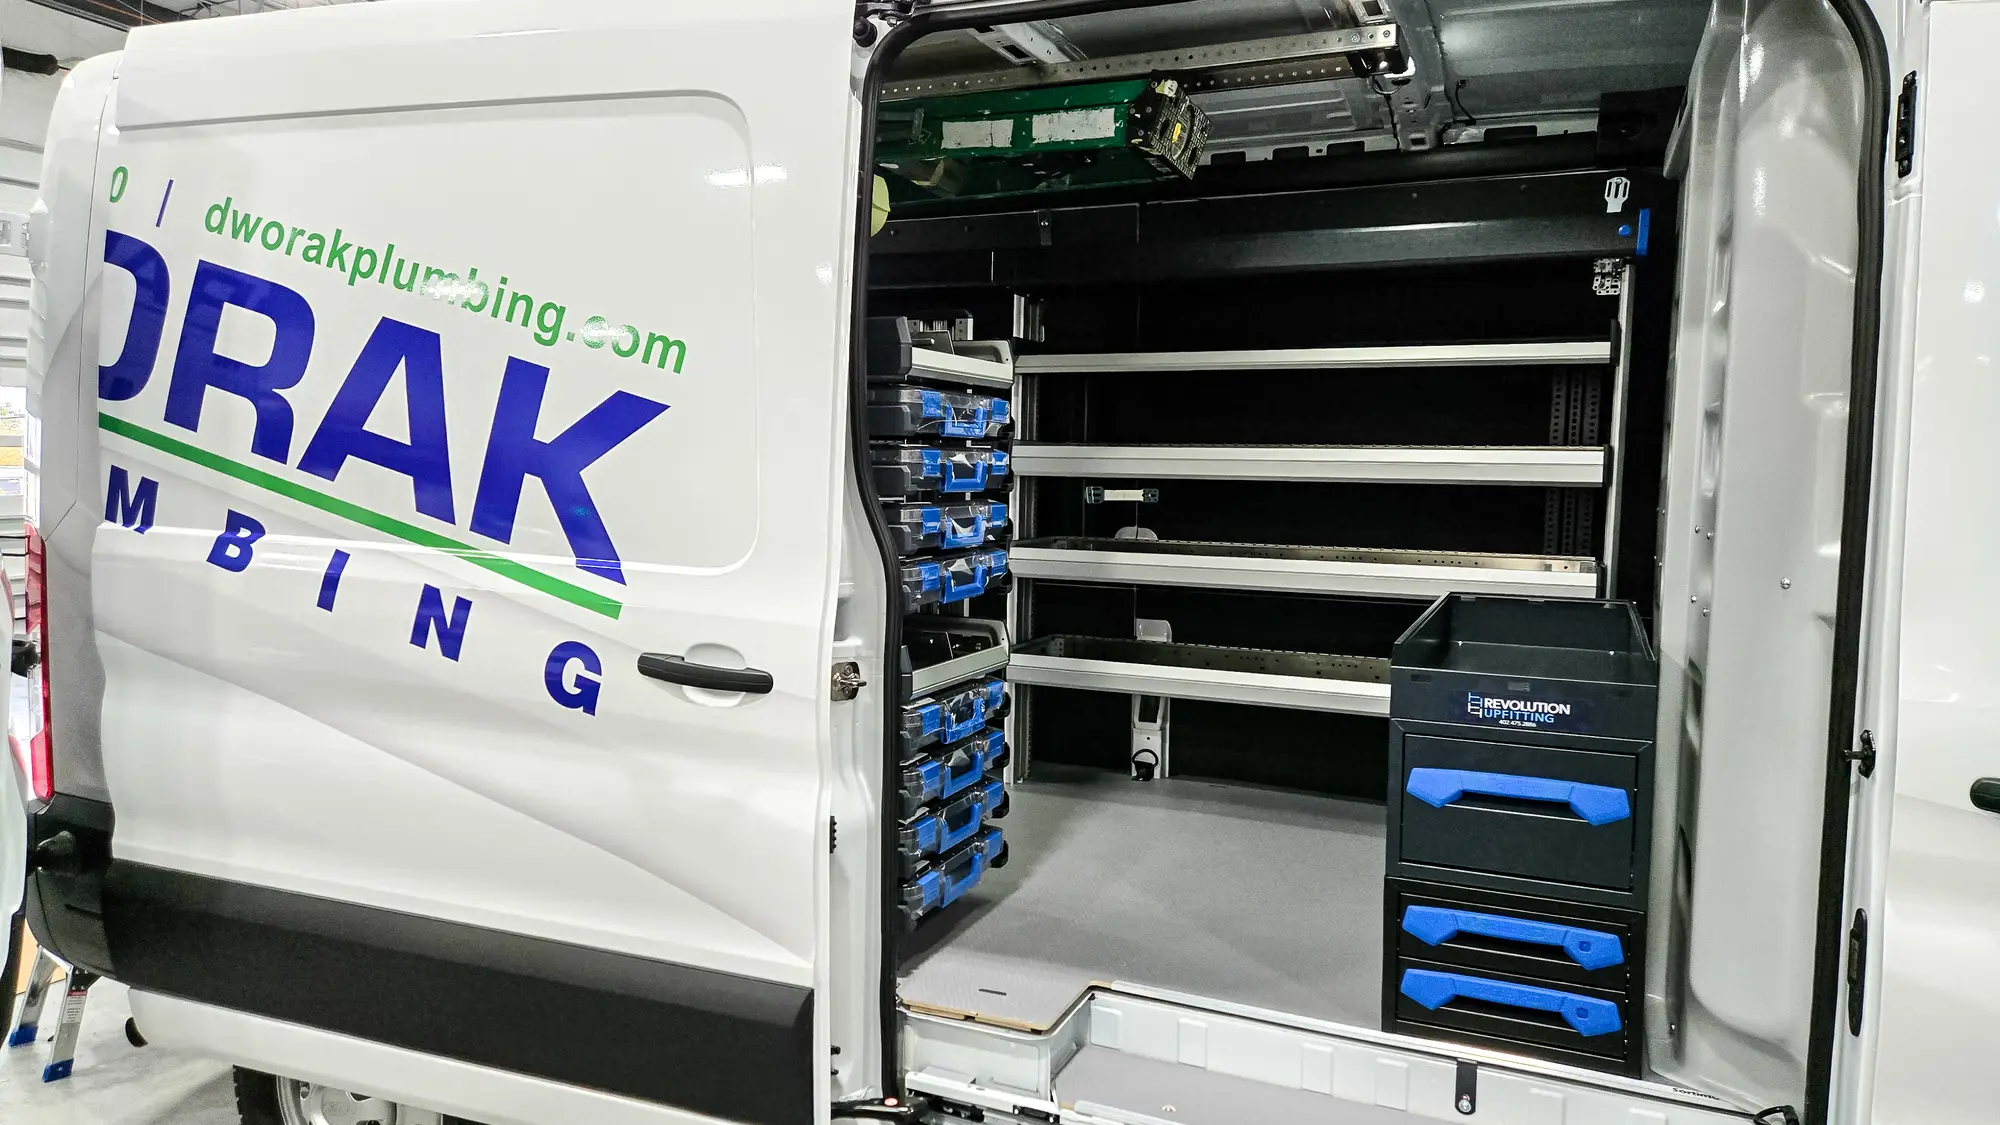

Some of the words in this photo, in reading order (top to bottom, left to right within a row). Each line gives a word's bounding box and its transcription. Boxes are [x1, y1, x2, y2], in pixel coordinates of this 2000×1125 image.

[205, 196, 687, 374] dworakplumbing.com
[1484, 697, 1571, 715] REVOLUTION
[1484, 708, 1555, 723] UPFITTING
